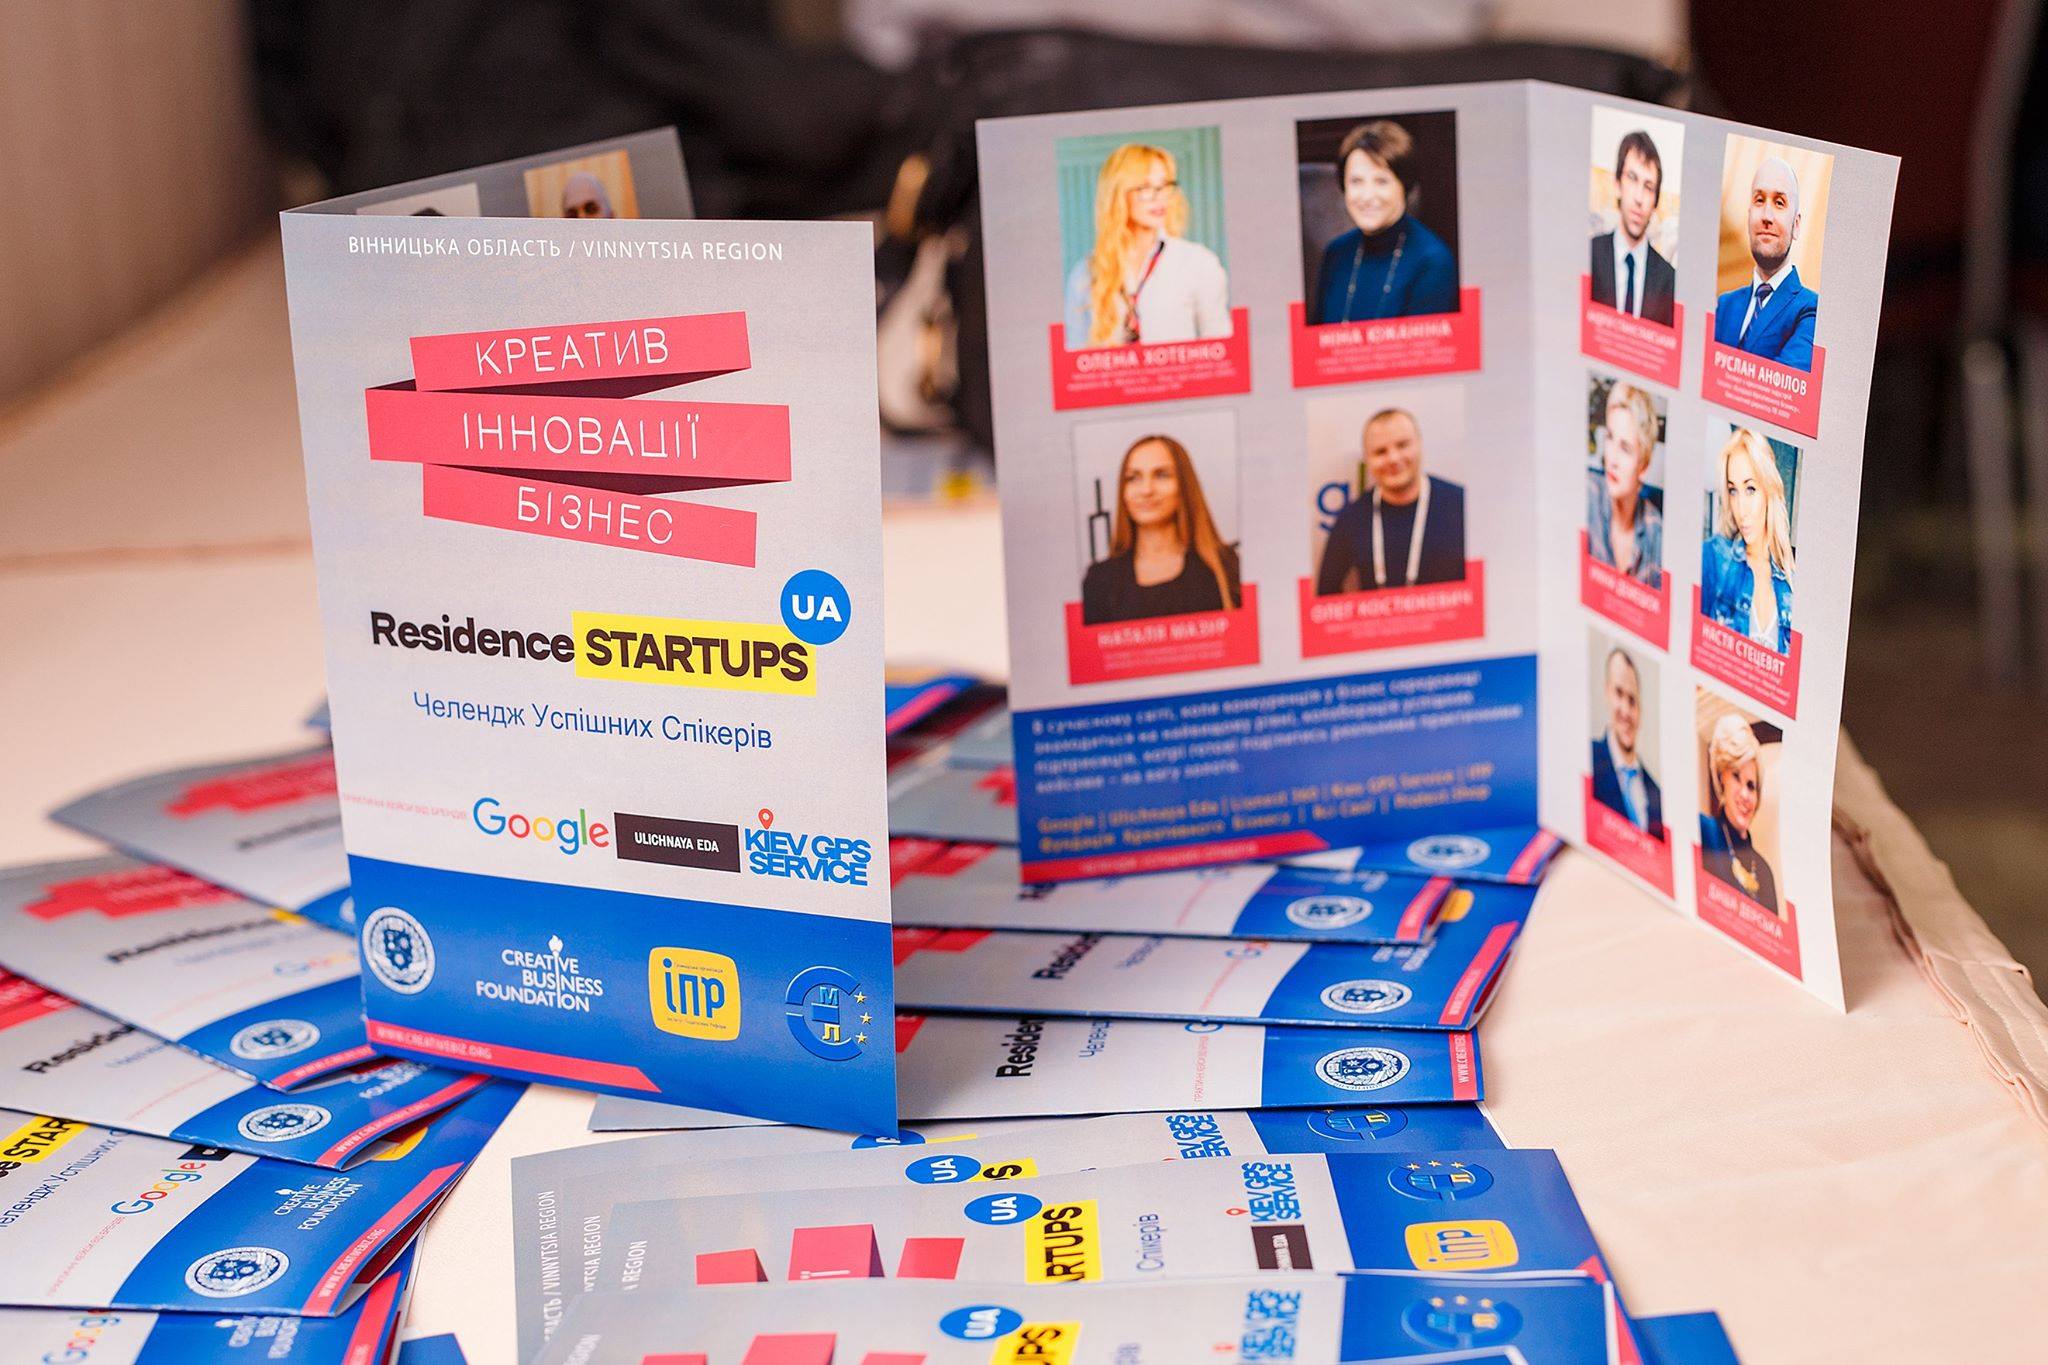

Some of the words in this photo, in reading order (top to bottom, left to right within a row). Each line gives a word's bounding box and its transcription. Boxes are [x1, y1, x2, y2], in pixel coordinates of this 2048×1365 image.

[348, 236, 460, 258] ВІННИЦЬКА
[467, 239, 561, 257] ОБЛАСТЬ
[582, 240, 694, 260] VINNYTSIA
[703, 242, 783, 261] REGION
[475, 327, 669, 375] КРЕАТИВ
[1714, 351, 1756, 378] РУСЛАН
[1758, 366, 1807, 396] АНФІЛОВ
[463, 412, 699, 460] ІННОВАЦІЇ
[517, 486, 673, 545] БІЗНЕС
[790, 595, 842, 622] UA
[371, 611, 575, 662] Residence
[586, 629, 808, 681] STARTUPS
[413, 691, 525, 728] Челендж
[532, 702, 653, 740] Успішних
[662, 715, 772, 752] Спікерів
[473, 797, 609, 855] Google
[634, 831, 693, 852] ULICHNAYA
[697, 836, 719, 854] EDA
[744, 828, 810, 856] KIEV
[811, 834, 871, 862] GPS
[750, 856, 868, 886] SERVICE
[502, 949, 579, 974] CREATIVE
[475, 980, 590, 1012] FOUNDATION
[522, 969, 603, 996] BUSINESS
[1166, 1114, 1197, 1140] GPS
[1194, 1114, 1232, 1157] ERVICE
[111, 1162, 206, 1214] Google
[930, 1158, 958, 1181] UA
[1241, 1162, 1270, 1189] GPS
[274, 1184, 321, 1215] CREATIVE
[297, 1183, 363, 1230] FOUNDATION
[538, 1190, 556, 1231] REGION
[991, 1196, 1018, 1221] UA
[1247, 1191, 1277, 1222] KIEV
[1268, 1163, 1302, 1220] SERVICE
[584, 1215, 601, 1256] REGION
[1042, 1206, 1085, 1281] RTUPS
[541, 1231, 560, 1292] VINNYTSIA
[622, 1240, 648, 1282] REGION
